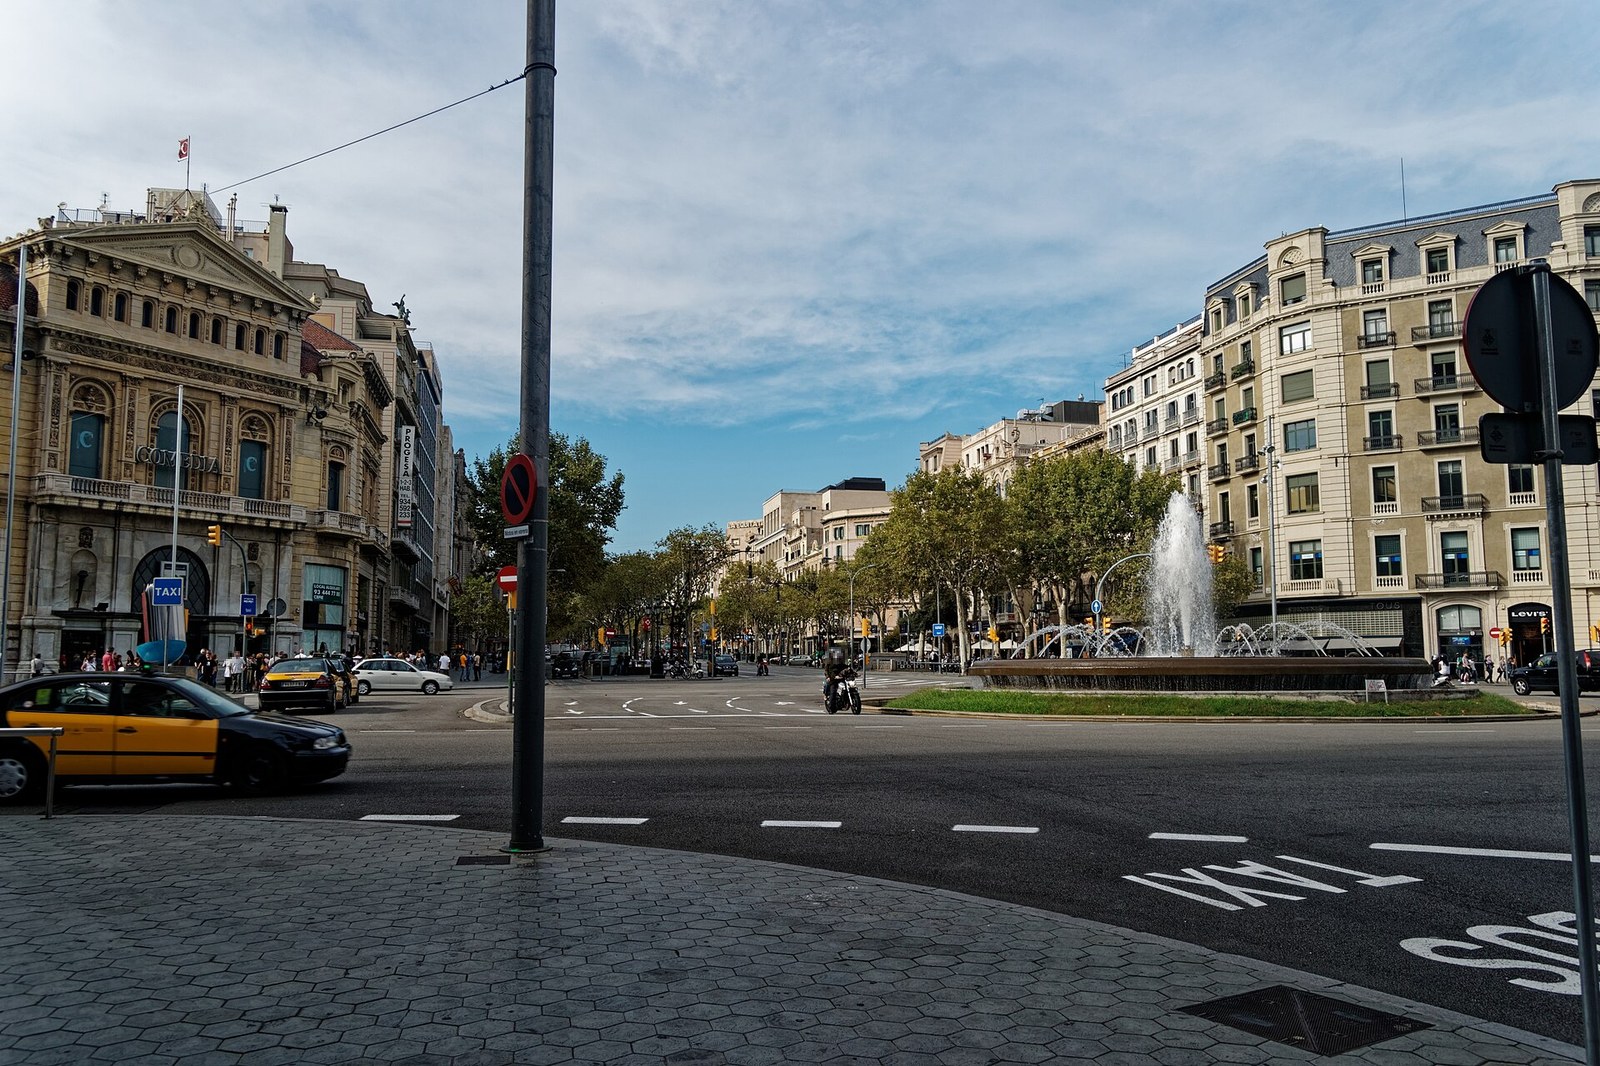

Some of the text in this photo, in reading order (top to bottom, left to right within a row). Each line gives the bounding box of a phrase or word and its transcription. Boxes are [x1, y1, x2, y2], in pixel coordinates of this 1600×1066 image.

[402, 428, 411, 477] PROGESA
[155, 587, 181, 596] TAXI
[1122, 855, 1424, 911] TAXI
